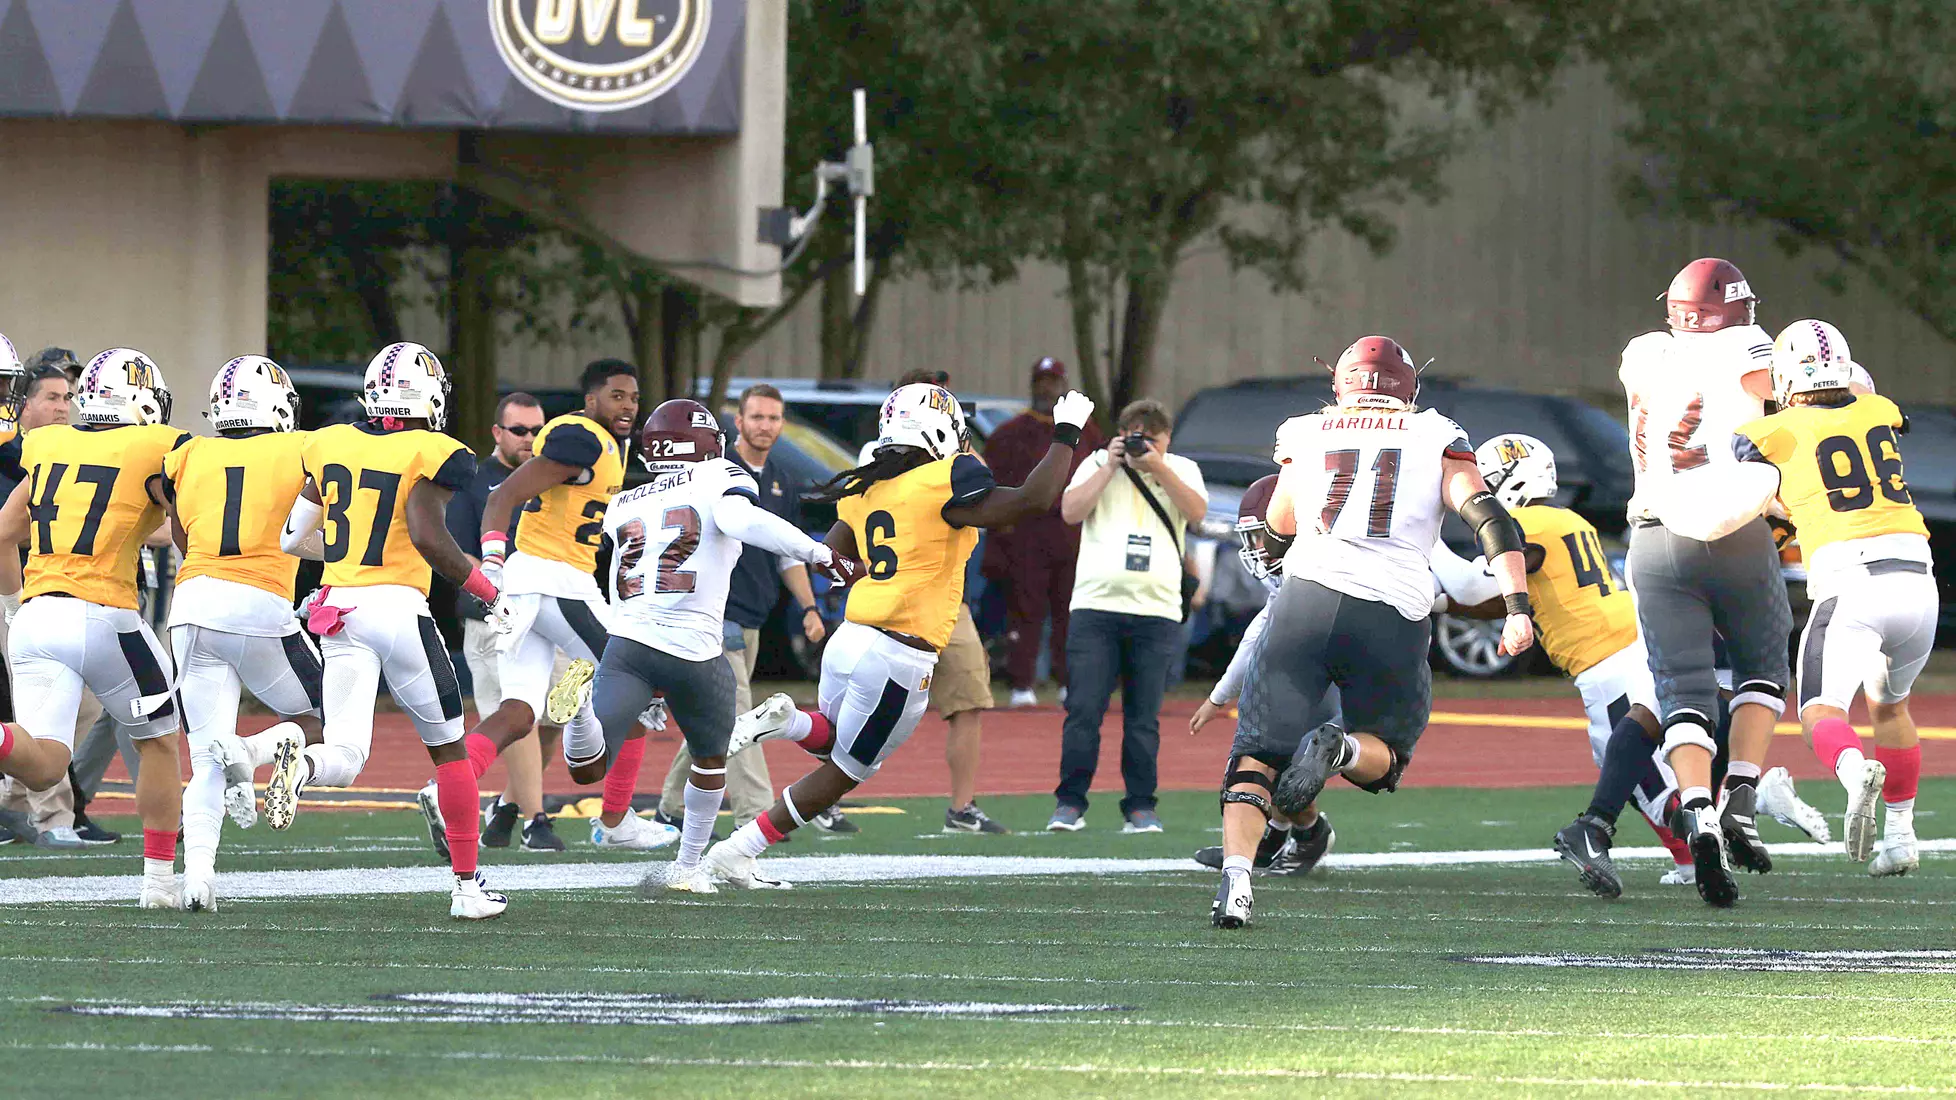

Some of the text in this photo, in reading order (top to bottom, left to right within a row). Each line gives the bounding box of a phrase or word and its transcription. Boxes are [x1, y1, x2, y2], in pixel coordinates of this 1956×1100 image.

[1724, 280, 1751, 303] EK
[1360, 370, 1380, 390] 71
[1813, 379, 1839, 389] PETERS
[214, 418, 249, 430] WARREN
[651, 439, 674, 457] 22
[1321, 417, 1409, 431] BARDALL
[1315, 448, 1402, 538] 71
[1816, 425, 1912, 513] 96
[28, 462, 120, 556] 47
[219, 466, 245, 556] 1
[321, 463, 402, 566] 37
[865, 509, 898, 581] 6
[615, 504, 702, 602] 22
